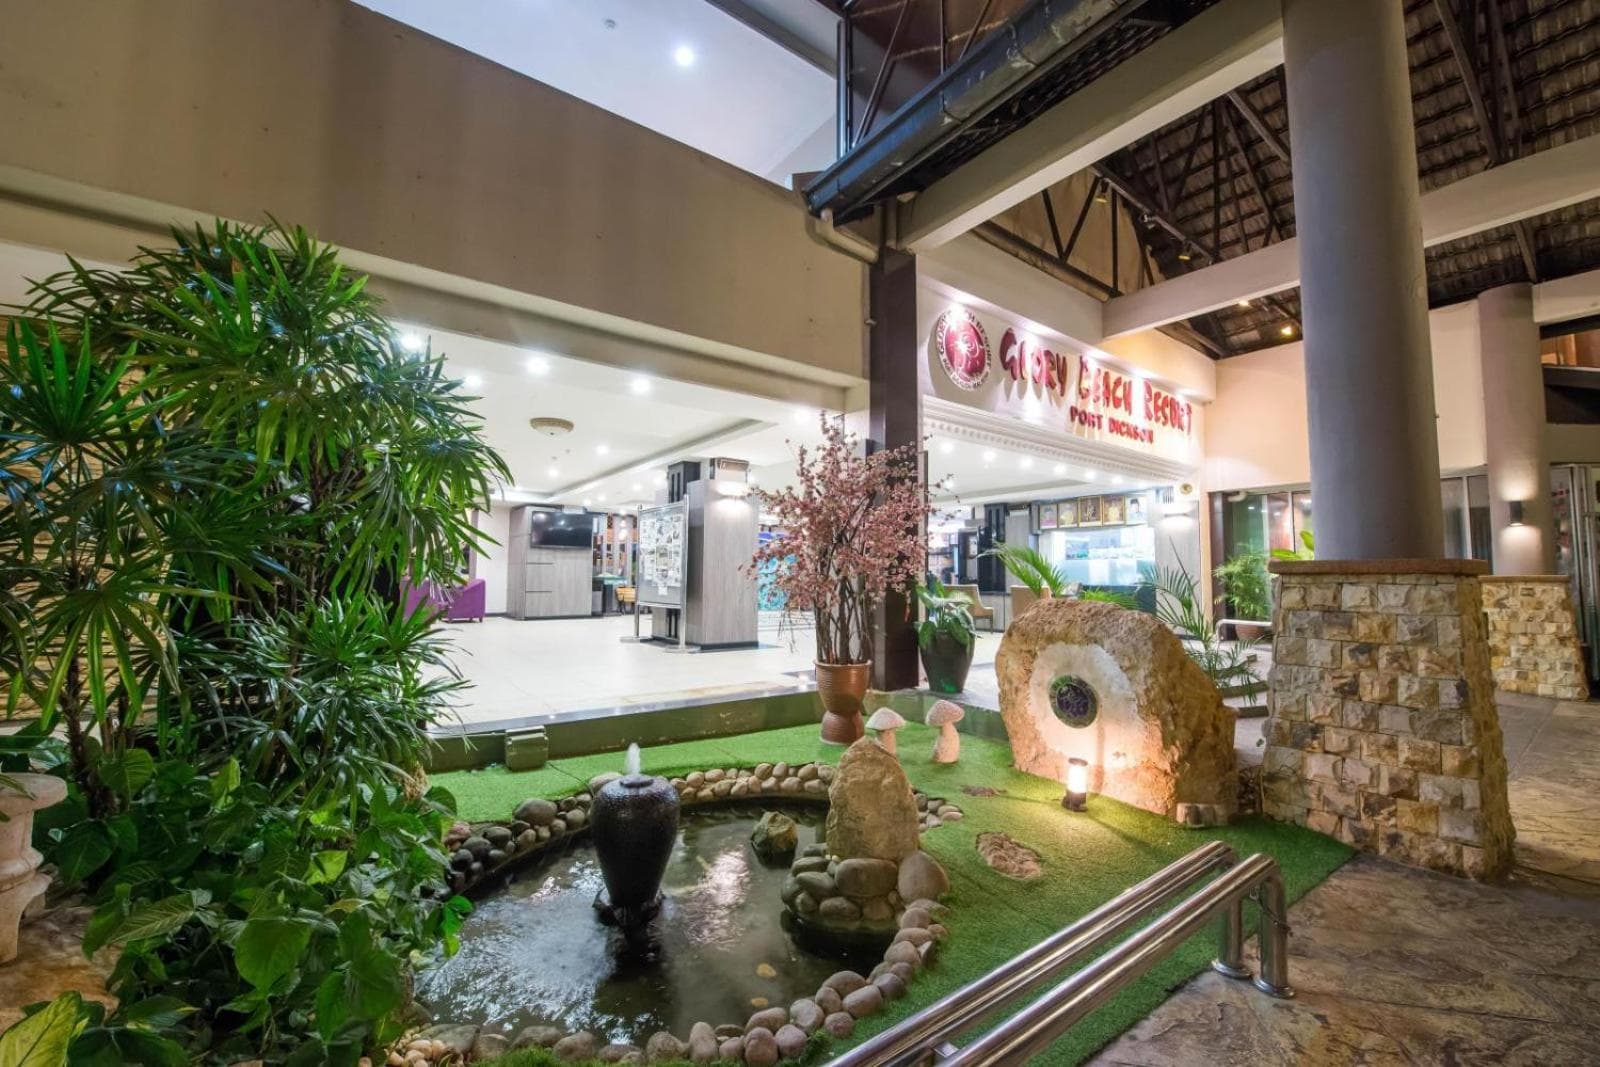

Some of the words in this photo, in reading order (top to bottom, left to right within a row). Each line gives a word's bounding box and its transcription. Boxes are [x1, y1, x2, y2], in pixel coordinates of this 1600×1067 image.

[999, 327, 1067, 397] GLORY
[1143, 378, 1192, 435] RESORT
[1070, 405, 1103, 430] PORT
